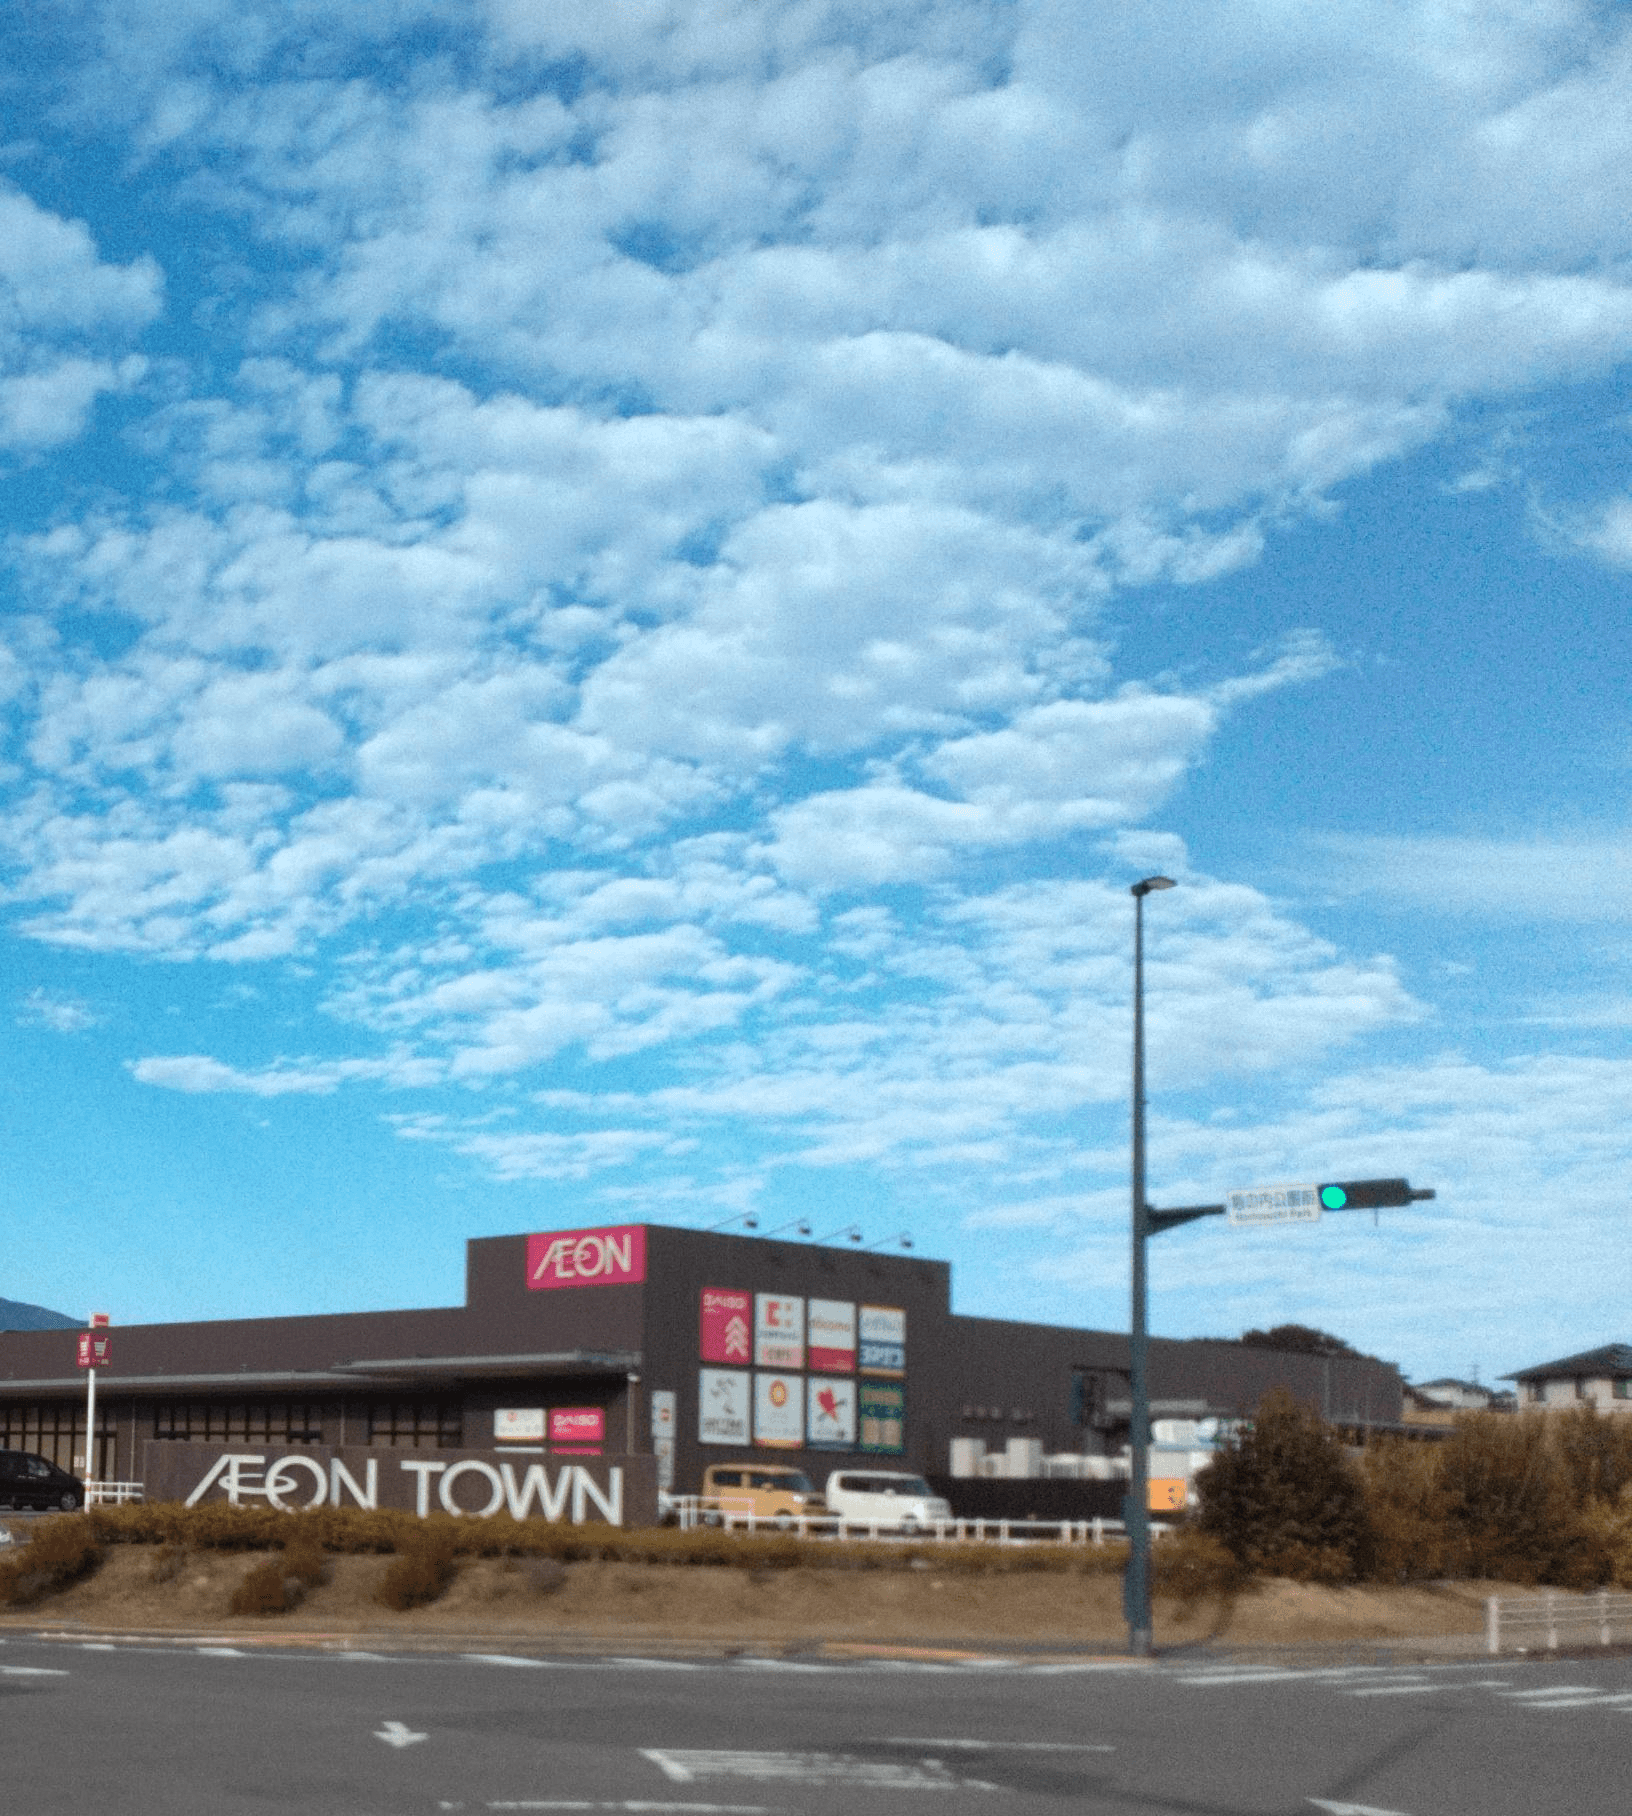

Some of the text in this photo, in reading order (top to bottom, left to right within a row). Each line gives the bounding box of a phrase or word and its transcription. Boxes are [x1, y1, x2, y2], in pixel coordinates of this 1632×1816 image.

[703, 1293, 748, 1309] DAISO
[553, 1414, 600, 1427] DAISO
[400, 1459, 624, 1527] TOWN
